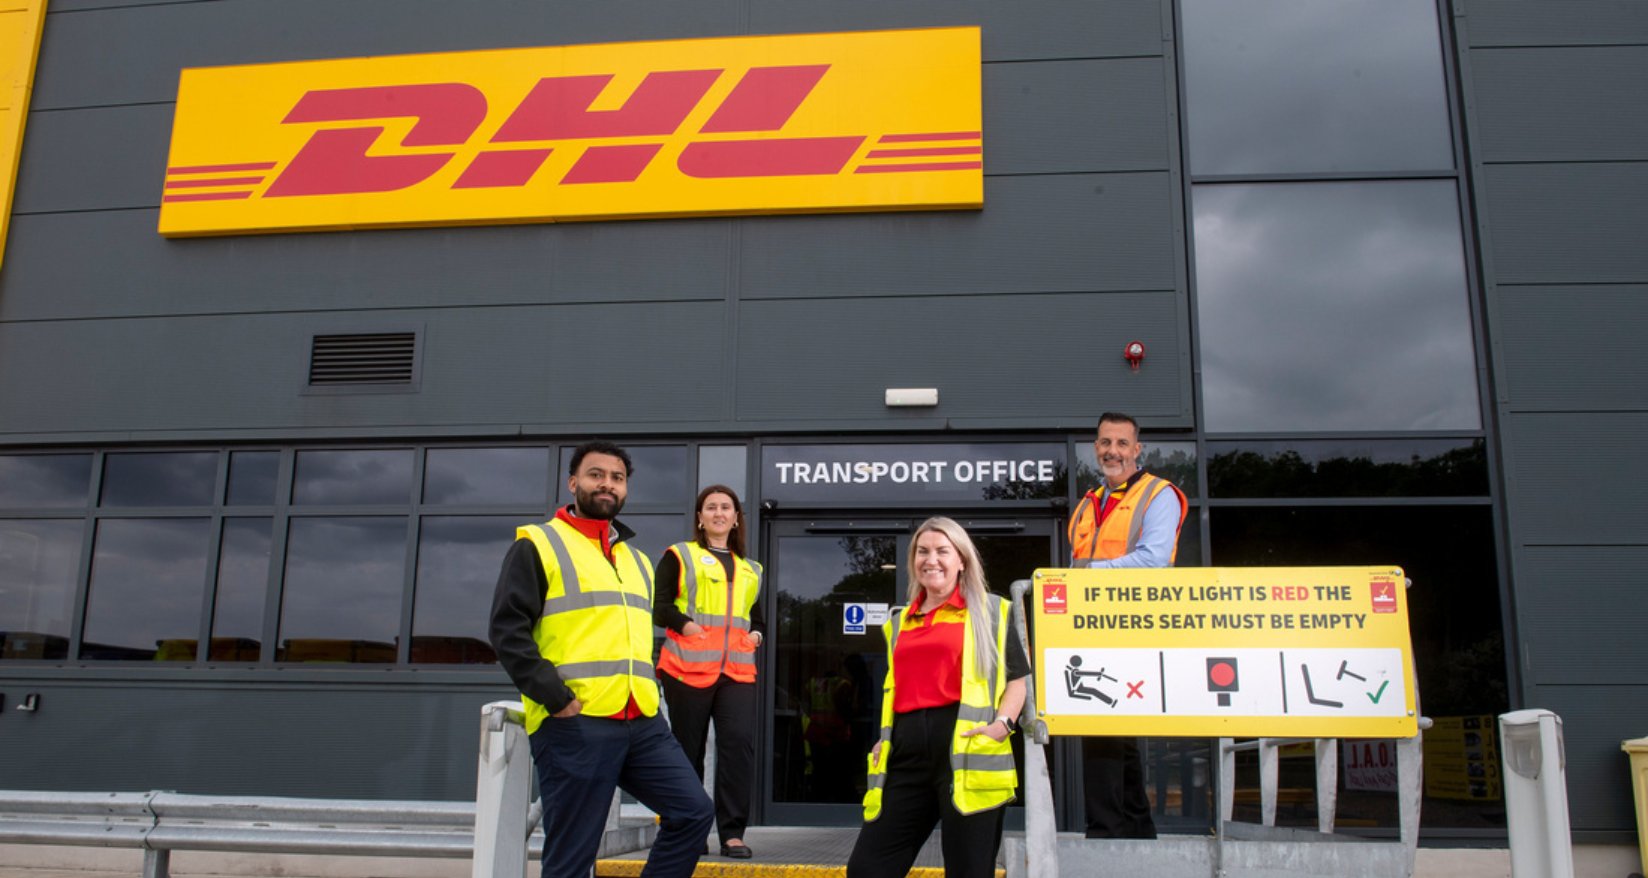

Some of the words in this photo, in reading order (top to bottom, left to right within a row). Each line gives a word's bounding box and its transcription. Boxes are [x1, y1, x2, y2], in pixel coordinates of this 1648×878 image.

[262, 64, 867, 197] DHL
[775, 460, 948, 483] TRANSPORT
[953, 459, 1054, 482] OFFICE
[1084, 586, 1101, 602] IF
[1105, 586, 1142, 602] THE
[1147, 586, 1183, 602] BAY
[1189, 586, 1244, 602] LIGHT
[1249, 586, 1267, 602] IS
[1271, 586, 1309, 602] RED
[1313, 586, 1352, 602] THE
[1073, 614, 1154, 629] DRIVERS
[1159, 614, 1206, 629] SEAT
[1211, 614, 1265, 629] MUST
[1270, 614, 1294, 629] BE
[1299, 614, 1366, 629] EMPTY
